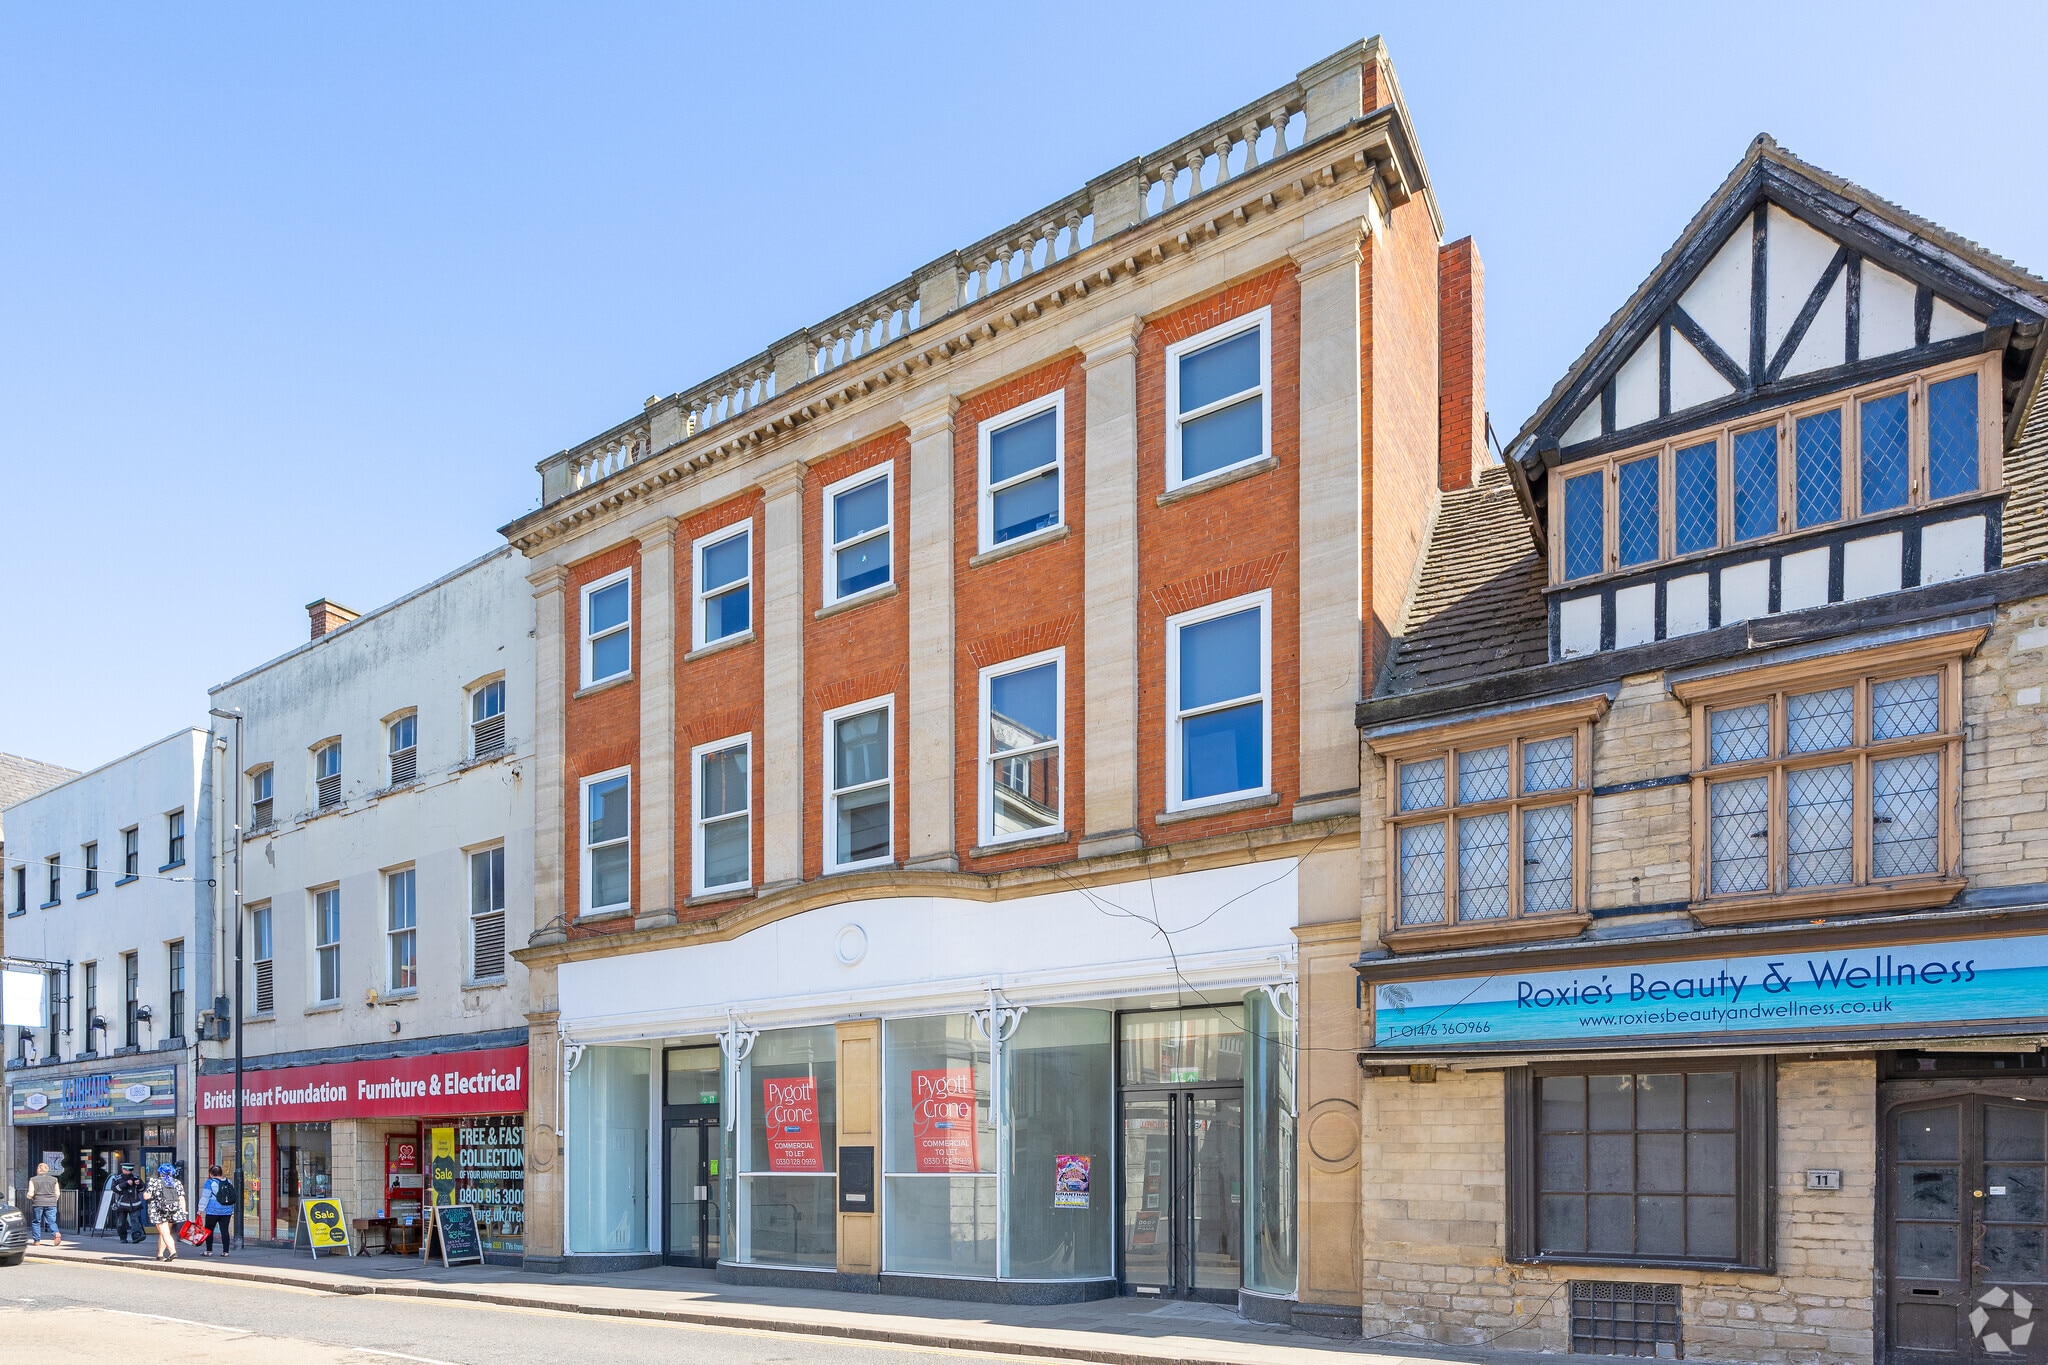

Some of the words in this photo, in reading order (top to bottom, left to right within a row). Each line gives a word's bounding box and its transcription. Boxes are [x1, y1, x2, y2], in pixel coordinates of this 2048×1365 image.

[1517, 974, 1613, 1009] Roxie's
[1630, 968, 1748, 1003] Beauty
[1762, 962, 1793, 994] &
[1807, 954, 1976, 991] Wellness
[1579, 996, 1893, 1027] www.roxiesbeautyandwellness.co.uk
[1401, 1024, 1438, 1037] 01476
[1442, 1021, 1491, 1035] 360966
[62, 1076, 110, 1109] KLUBHAUS
[242, 1088, 273, 1107] Heart
[275, 1081, 347, 1105] Foundation
[357, 1076, 427, 1100] Furniture
[429, 1073, 442, 1096] &
[444, 1067, 521, 1095] Electrical
[769, 1082, 811, 1106] Pygott
[918, 1075, 968, 1099] Pygott
[774, 1105, 813, 1123] Crone
[923, 1100, 969, 1118] Crone
[460, 1127, 486, 1145] FREE
[487, 1127, 498, 1145] &
[499, 1126, 524, 1145] FAST
[774, 1142, 814, 1150] COMMERCIAL
[935, 1148, 945, 1156] TO
[945, 1148, 958, 1156] LET
[460, 1148, 524, 1167] COLLECTION
[435, 1167, 453, 1180] Sale
[460, 1170, 467, 1179] OF
[467, 1170, 480, 1179] YOUR
[480, 1170, 510, 1180] UNWANTED
[1815, 1175, 1828, 1186] 11
[460, 1188, 484, 1204] 0800
[486, 1188, 501, 1204] 915
[315, 1210, 335, 1219] Sale
